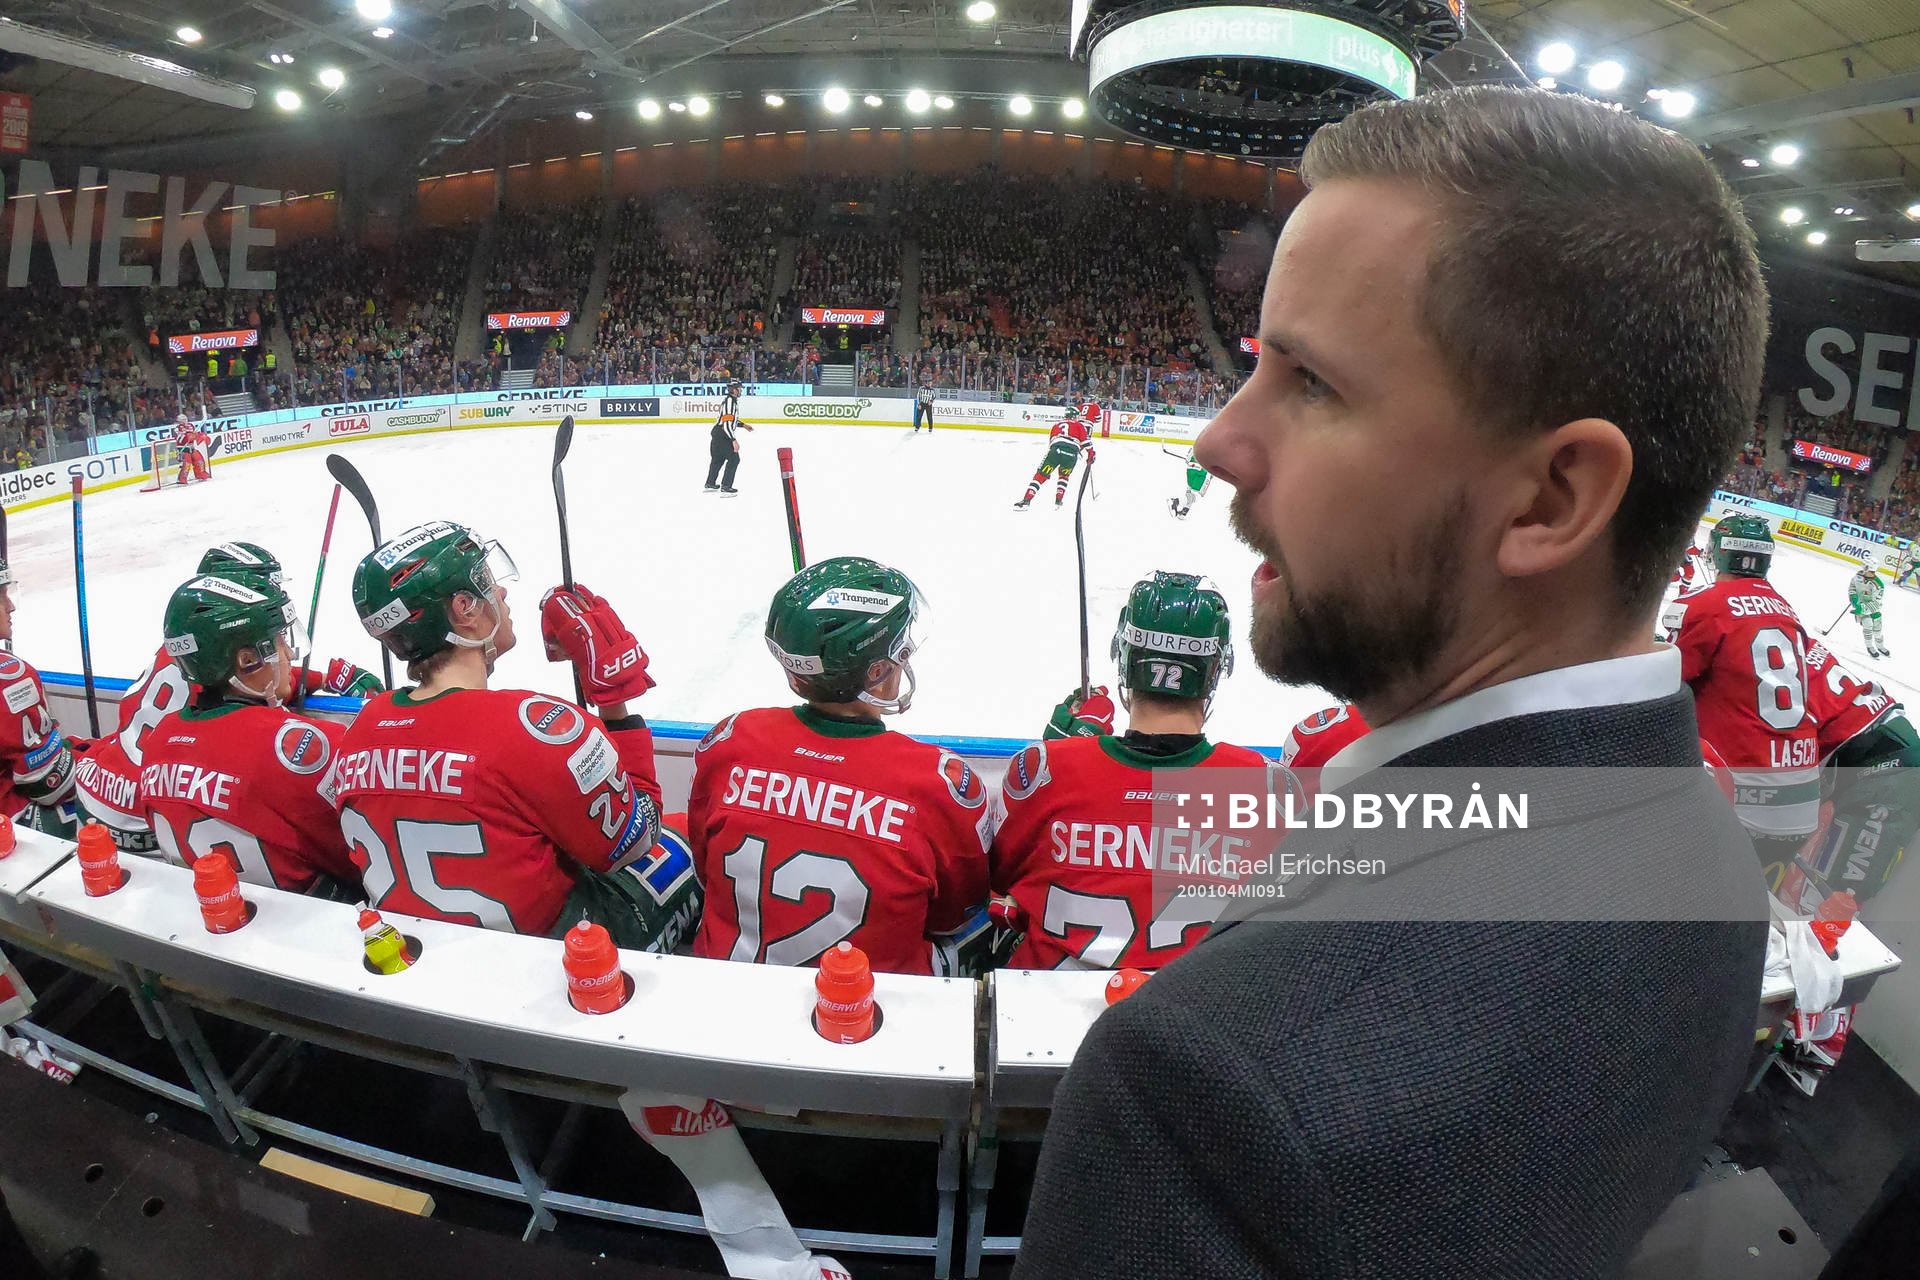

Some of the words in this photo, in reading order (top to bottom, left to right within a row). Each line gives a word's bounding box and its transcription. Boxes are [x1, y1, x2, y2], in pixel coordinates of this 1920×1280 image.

[1338, 33, 1381, 68] plus
[508, 314, 551, 327] Renova
[822, 309, 865, 323] Renova
[191, 335, 237, 350] Renova
[1798, 326, 1920, 433] SE
[459, 406, 513, 420] SUBWAY
[541, 402, 588, 413] STING
[606, 402, 653, 413] BRIXLY
[784, 403, 862, 418] CASHBUDDY
[933, 406, 965, 416] TRAVEL
[967, 407, 1005, 418] SERVICE
[331, 417, 369, 433] JULA
[387, 412, 441, 427] CASHBUDDY
[223, 429, 253, 443] INTER
[262, 433, 287, 445] KUMHO
[287, 430, 305, 441] TYRE
[1058, 422, 1070, 437] 3
[224, 440, 253, 455] SPORT
[1811, 445, 1851, 466] Renova
[67, 454, 130, 484] SOTI
[0, 471, 57, 498] idbec
[1836, 541, 1871, 560] KPMG
[214, 580, 254, 600] Tranpenad
[840, 592, 889, 606] Tranpenad
[1134, 629, 1218, 654] BJURFORS
[1150, 663, 1183, 690] 72
[537, 703, 566, 731] VOLVO
[22, 704, 53, 748] 44
[292, 730, 313, 763] VOLVO
[1770, 737, 1817, 768] LASCH
[1842, 805, 1889, 881] STENA
[723, 834, 871, 966] 12
